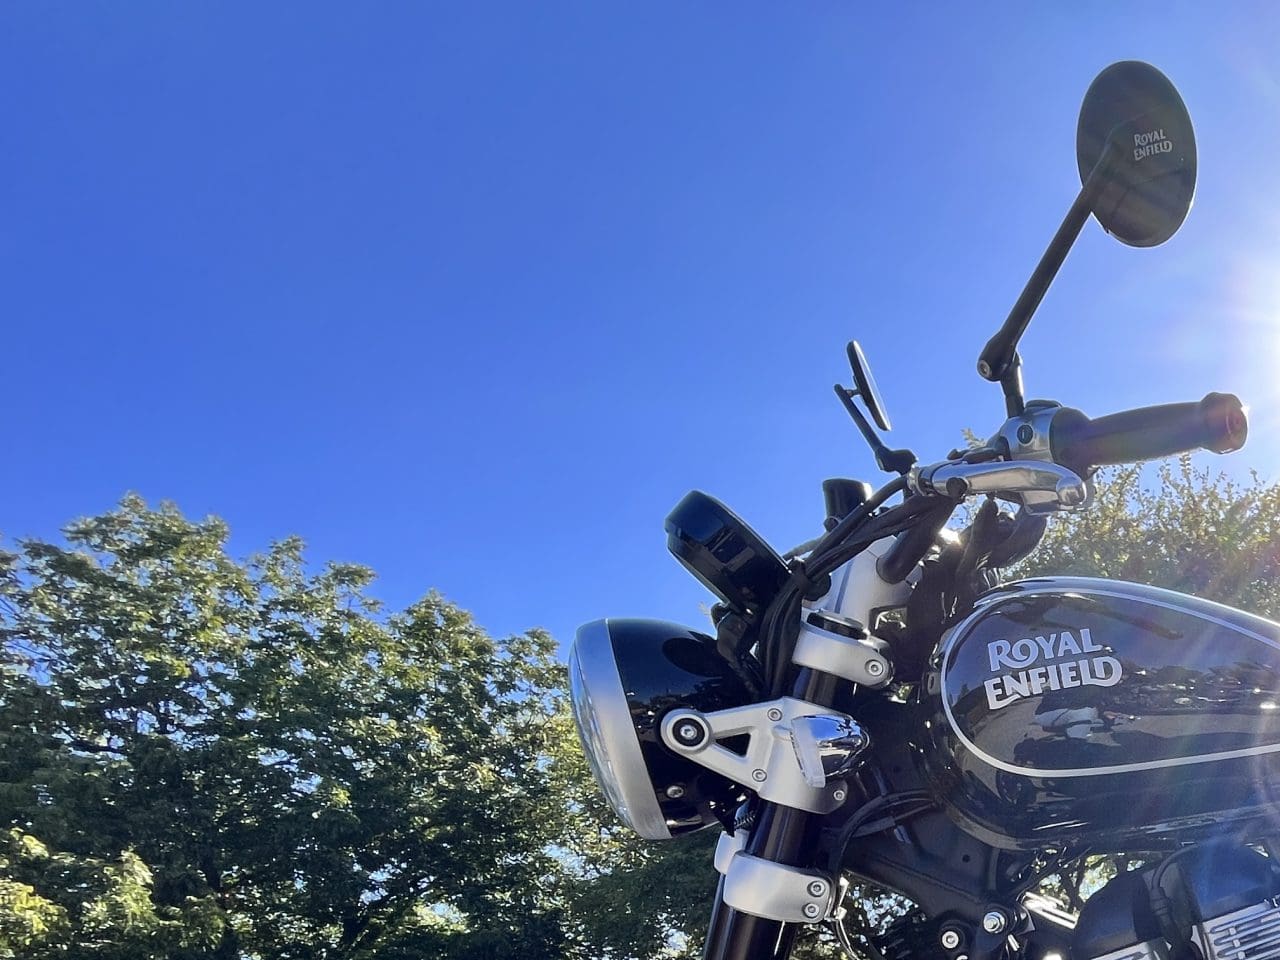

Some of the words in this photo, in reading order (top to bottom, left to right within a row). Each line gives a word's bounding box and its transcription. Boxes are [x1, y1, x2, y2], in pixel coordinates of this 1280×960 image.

[1133, 140, 1173, 161] ENFIELD
[1134, 129, 1166, 147] ROYAL
[987, 628, 1102, 672] ROYAL
[984, 656, 1123, 710] ENFIELD
